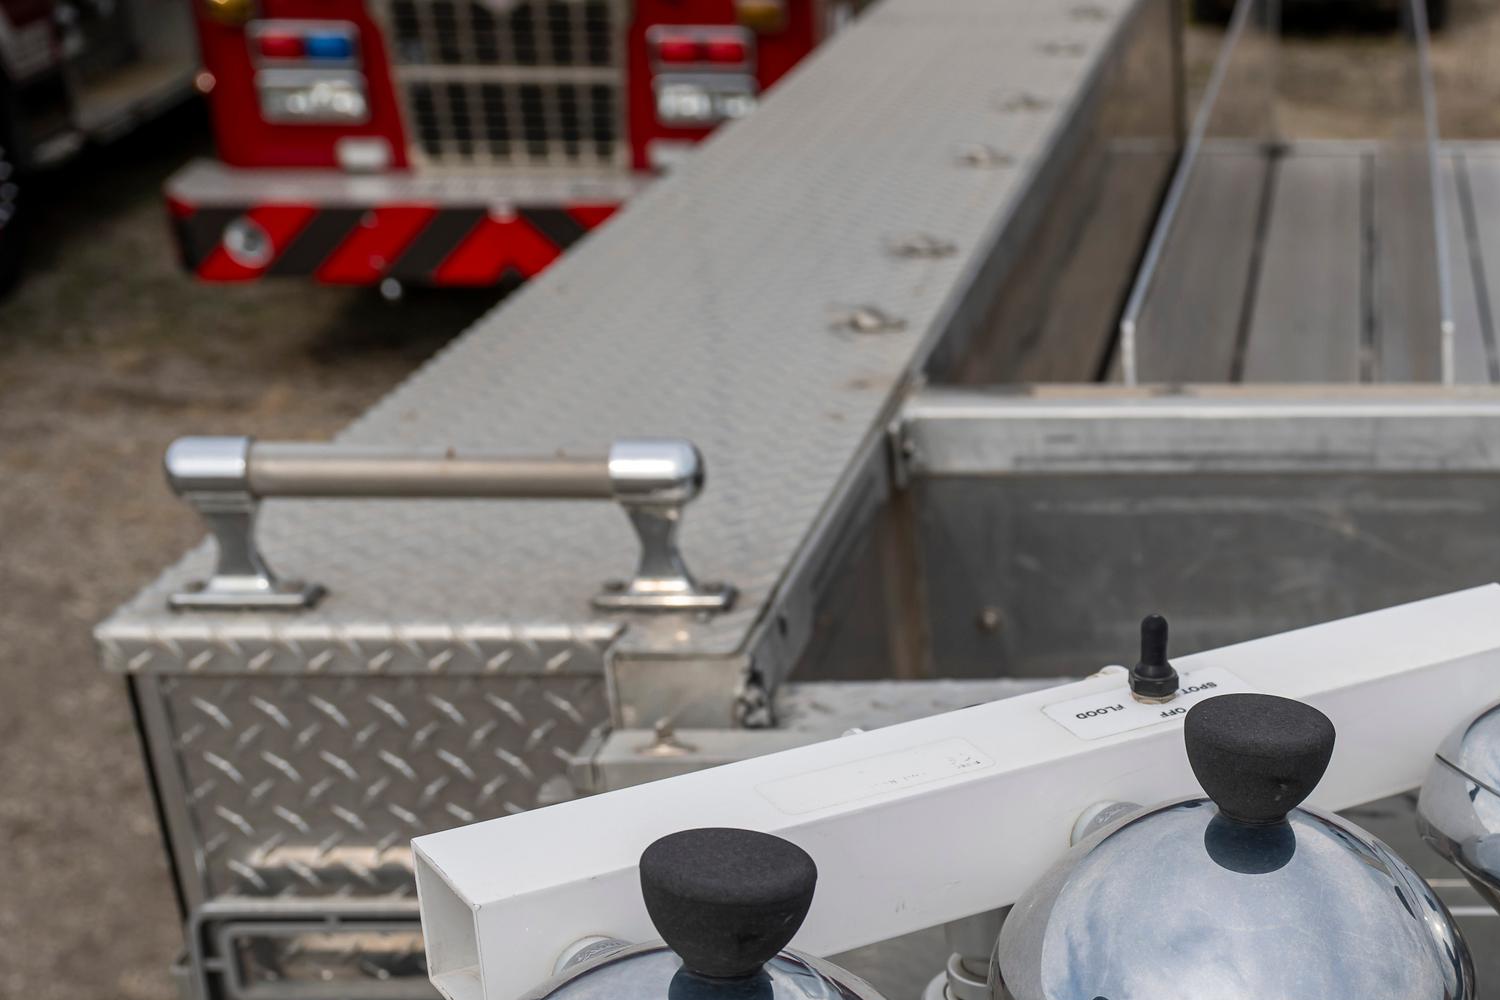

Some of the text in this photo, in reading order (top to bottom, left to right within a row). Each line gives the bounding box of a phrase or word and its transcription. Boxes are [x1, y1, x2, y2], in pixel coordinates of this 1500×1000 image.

[1181, 681, 1218, 694] SPOT
[1076, 704, 1126, 720] FLOOD
[1160, 708, 1187, 718] OFF
